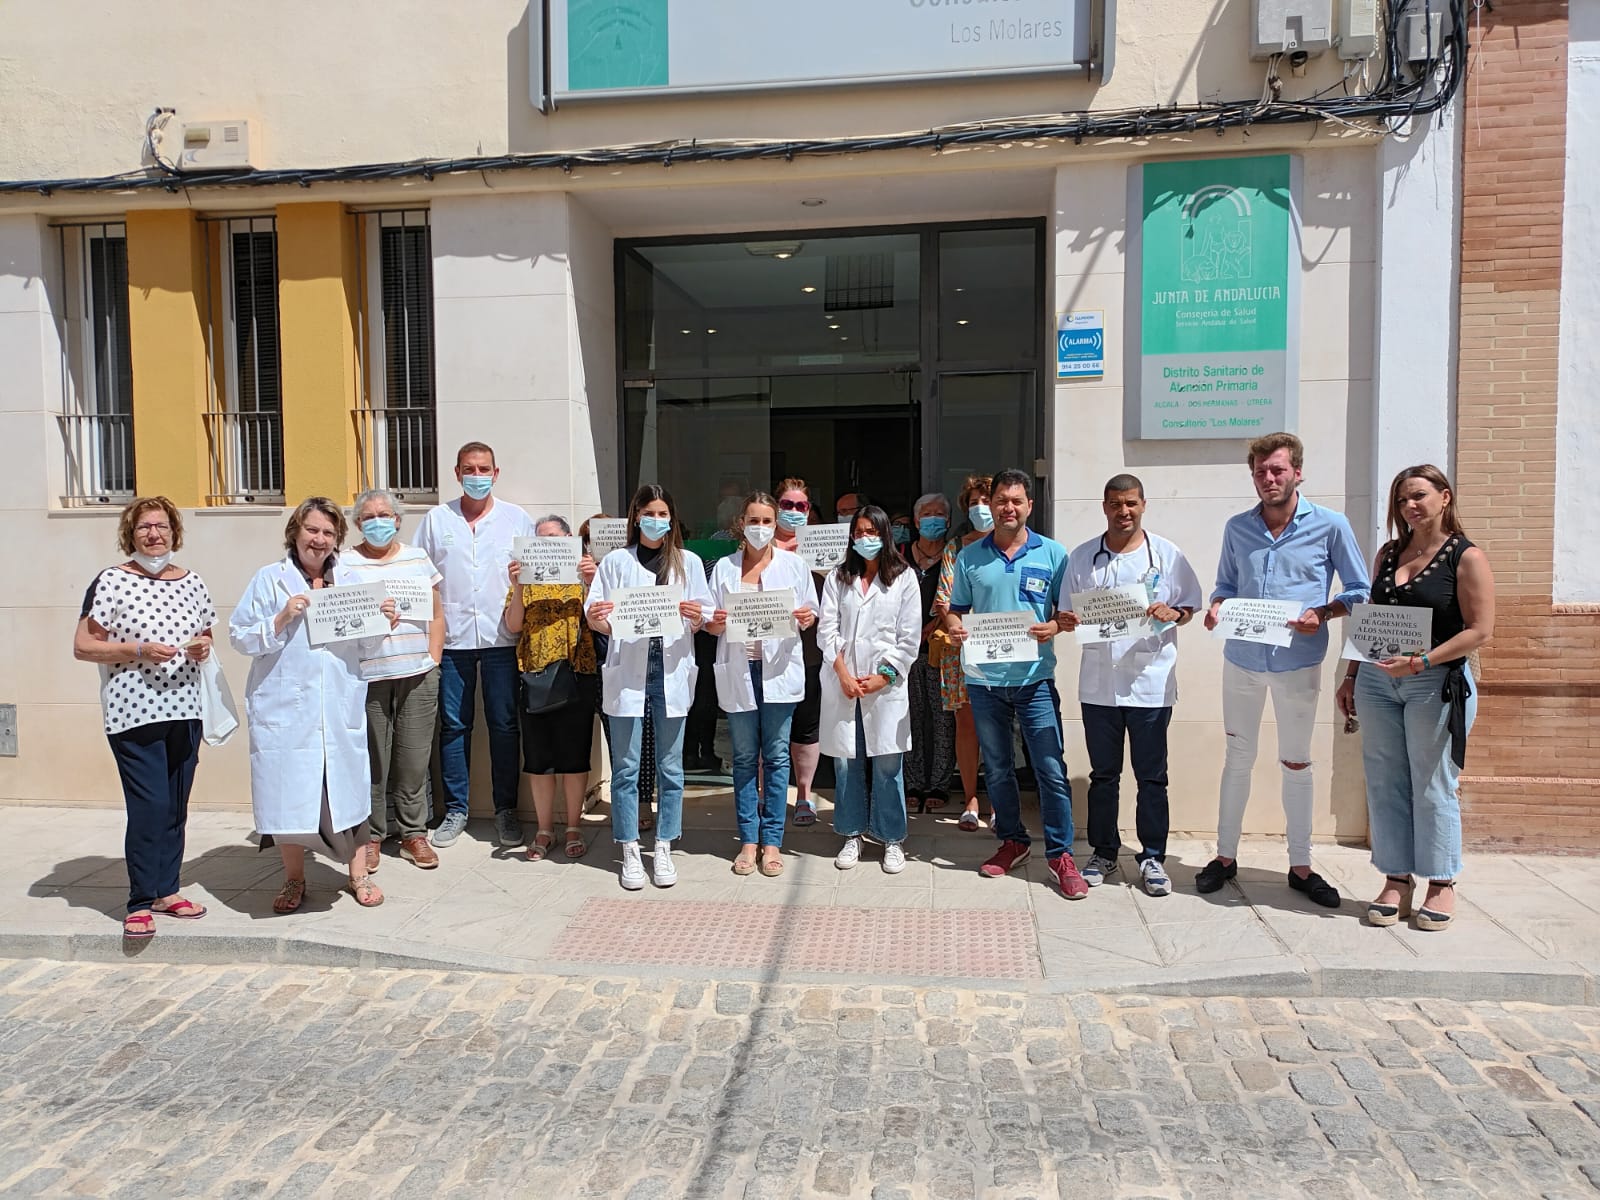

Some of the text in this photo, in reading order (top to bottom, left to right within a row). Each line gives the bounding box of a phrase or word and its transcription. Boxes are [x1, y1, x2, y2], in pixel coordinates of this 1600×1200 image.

[950, 18, 1062, 43] Los Molares
[1152, 291, 1189, 304] JUNTA
[1195, 290, 1208, 302] DE
[1220, 308, 1232, 317] de
[1234, 307, 1256, 316] Salud
[1068, 338, 1093, 346] ALARMA
[1164, 364, 1264, 378] Distrito Sanitario de
[1216, 380, 1258, 391] Primaria
[328, 597, 375, 606] AGRESIONES
[1093, 599, 1138, 610] AGRESIONES
[337, 604, 380, 614] SANITARIOS
[1101, 606, 1144, 615] SANITARIOS
[316, 613, 360, 624] TOLERANCIA
[1081, 616, 1124, 626] TOLERANCIA
[1372, 620, 1417, 628] AGRESIONES
[1378, 628, 1422, 638] SANITARIOS
[1354, 634, 1400, 644] TOLERANCIA
